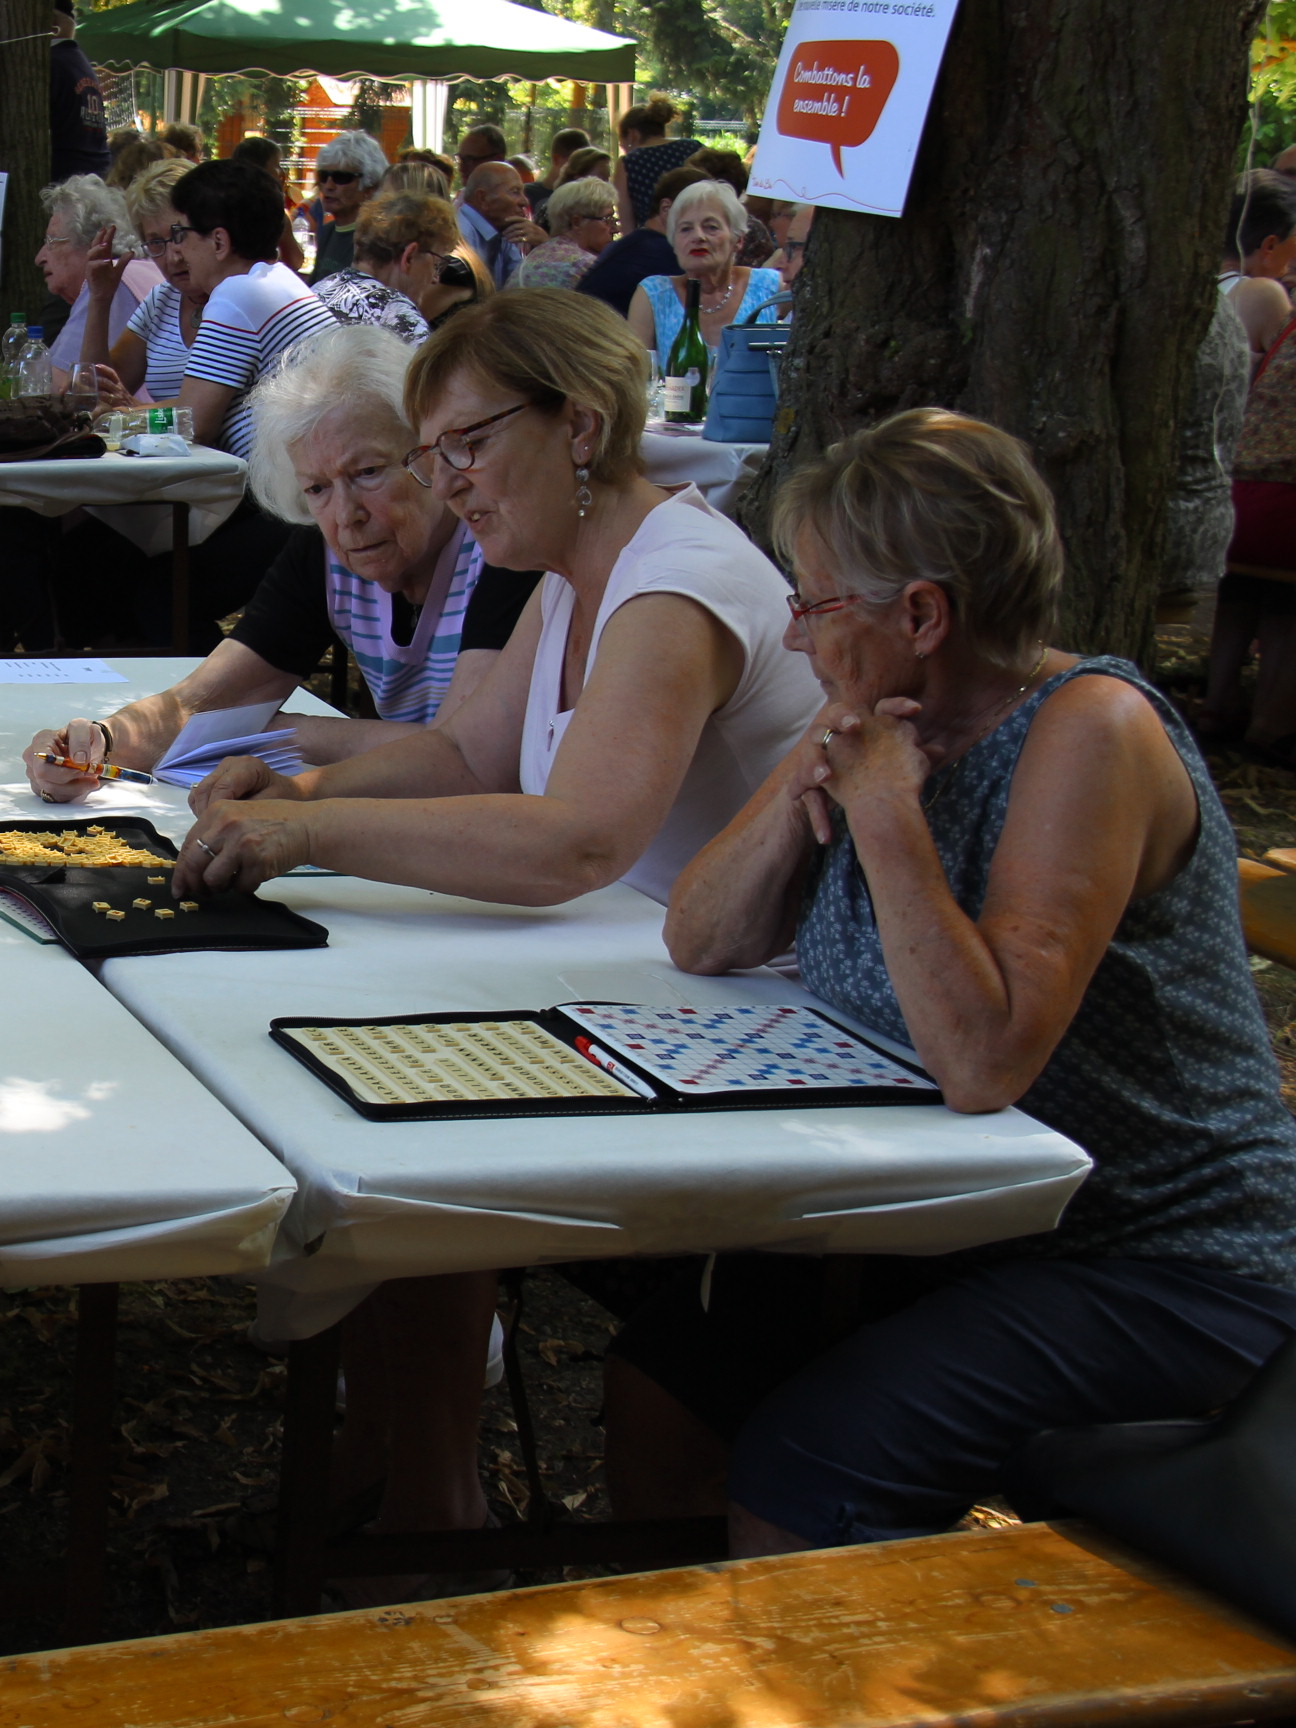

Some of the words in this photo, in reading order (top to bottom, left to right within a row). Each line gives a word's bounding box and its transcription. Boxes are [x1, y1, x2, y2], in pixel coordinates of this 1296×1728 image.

[847, 0, 859, 12] de
[861, 2, 891, 14] notre
[891, 4, 936, 17] société.
[793, 61, 854, 86] Combattons
[856, 65, 871, 88] la
[793, 92, 839, 116] ensemble
[840, 95, 849, 116] !
